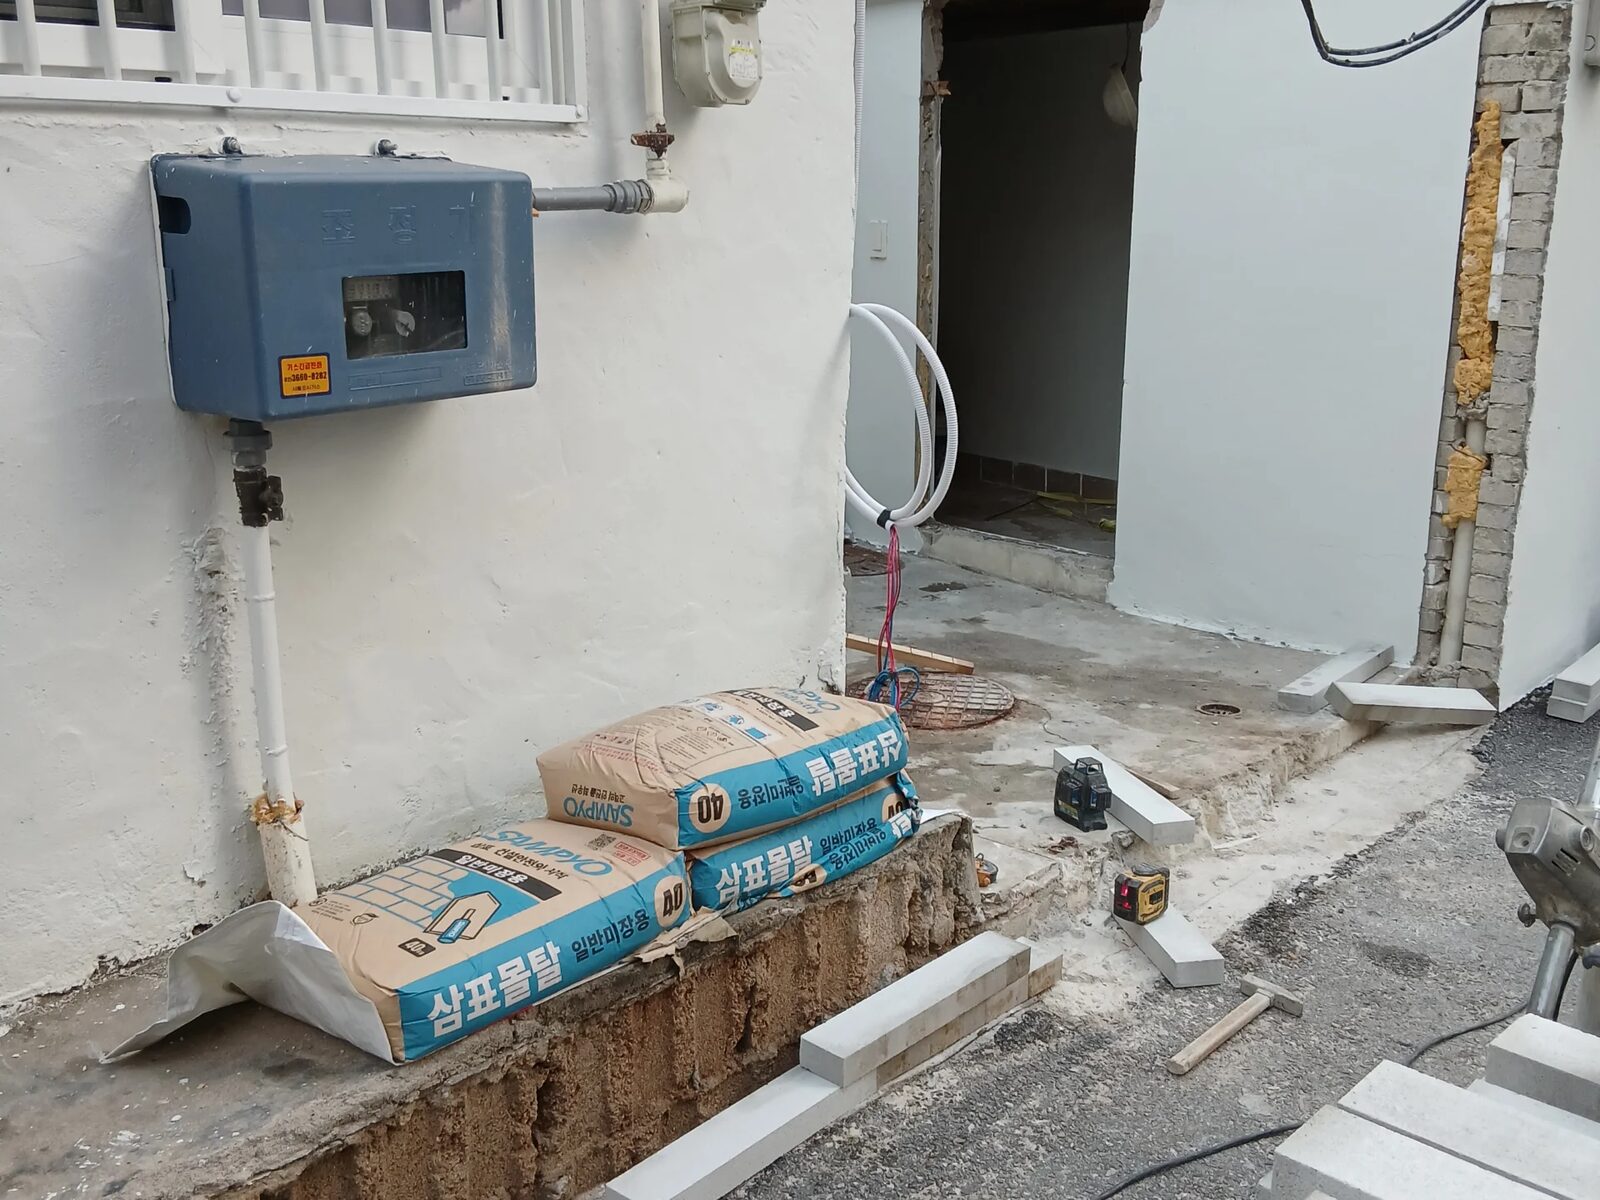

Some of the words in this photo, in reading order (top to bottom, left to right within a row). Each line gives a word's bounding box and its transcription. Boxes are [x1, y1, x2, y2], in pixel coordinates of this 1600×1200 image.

[737, 775, 804, 810] 일반미장용
[805, 729, 902, 797] 삼표몰탈
[563, 797, 635, 828] SAMPYO
[697, 793, 724, 823] 40
[455, 854, 529, 884] 일반미장용
[480, 830, 613, 876] SAMPYO
[715, 834, 813, 905] 삼표몰탈
[661, 882, 684, 918] 40
[427, 940, 564, 1038] 삼표몰탈
[571, 908, 650, 964] 일반미장용
